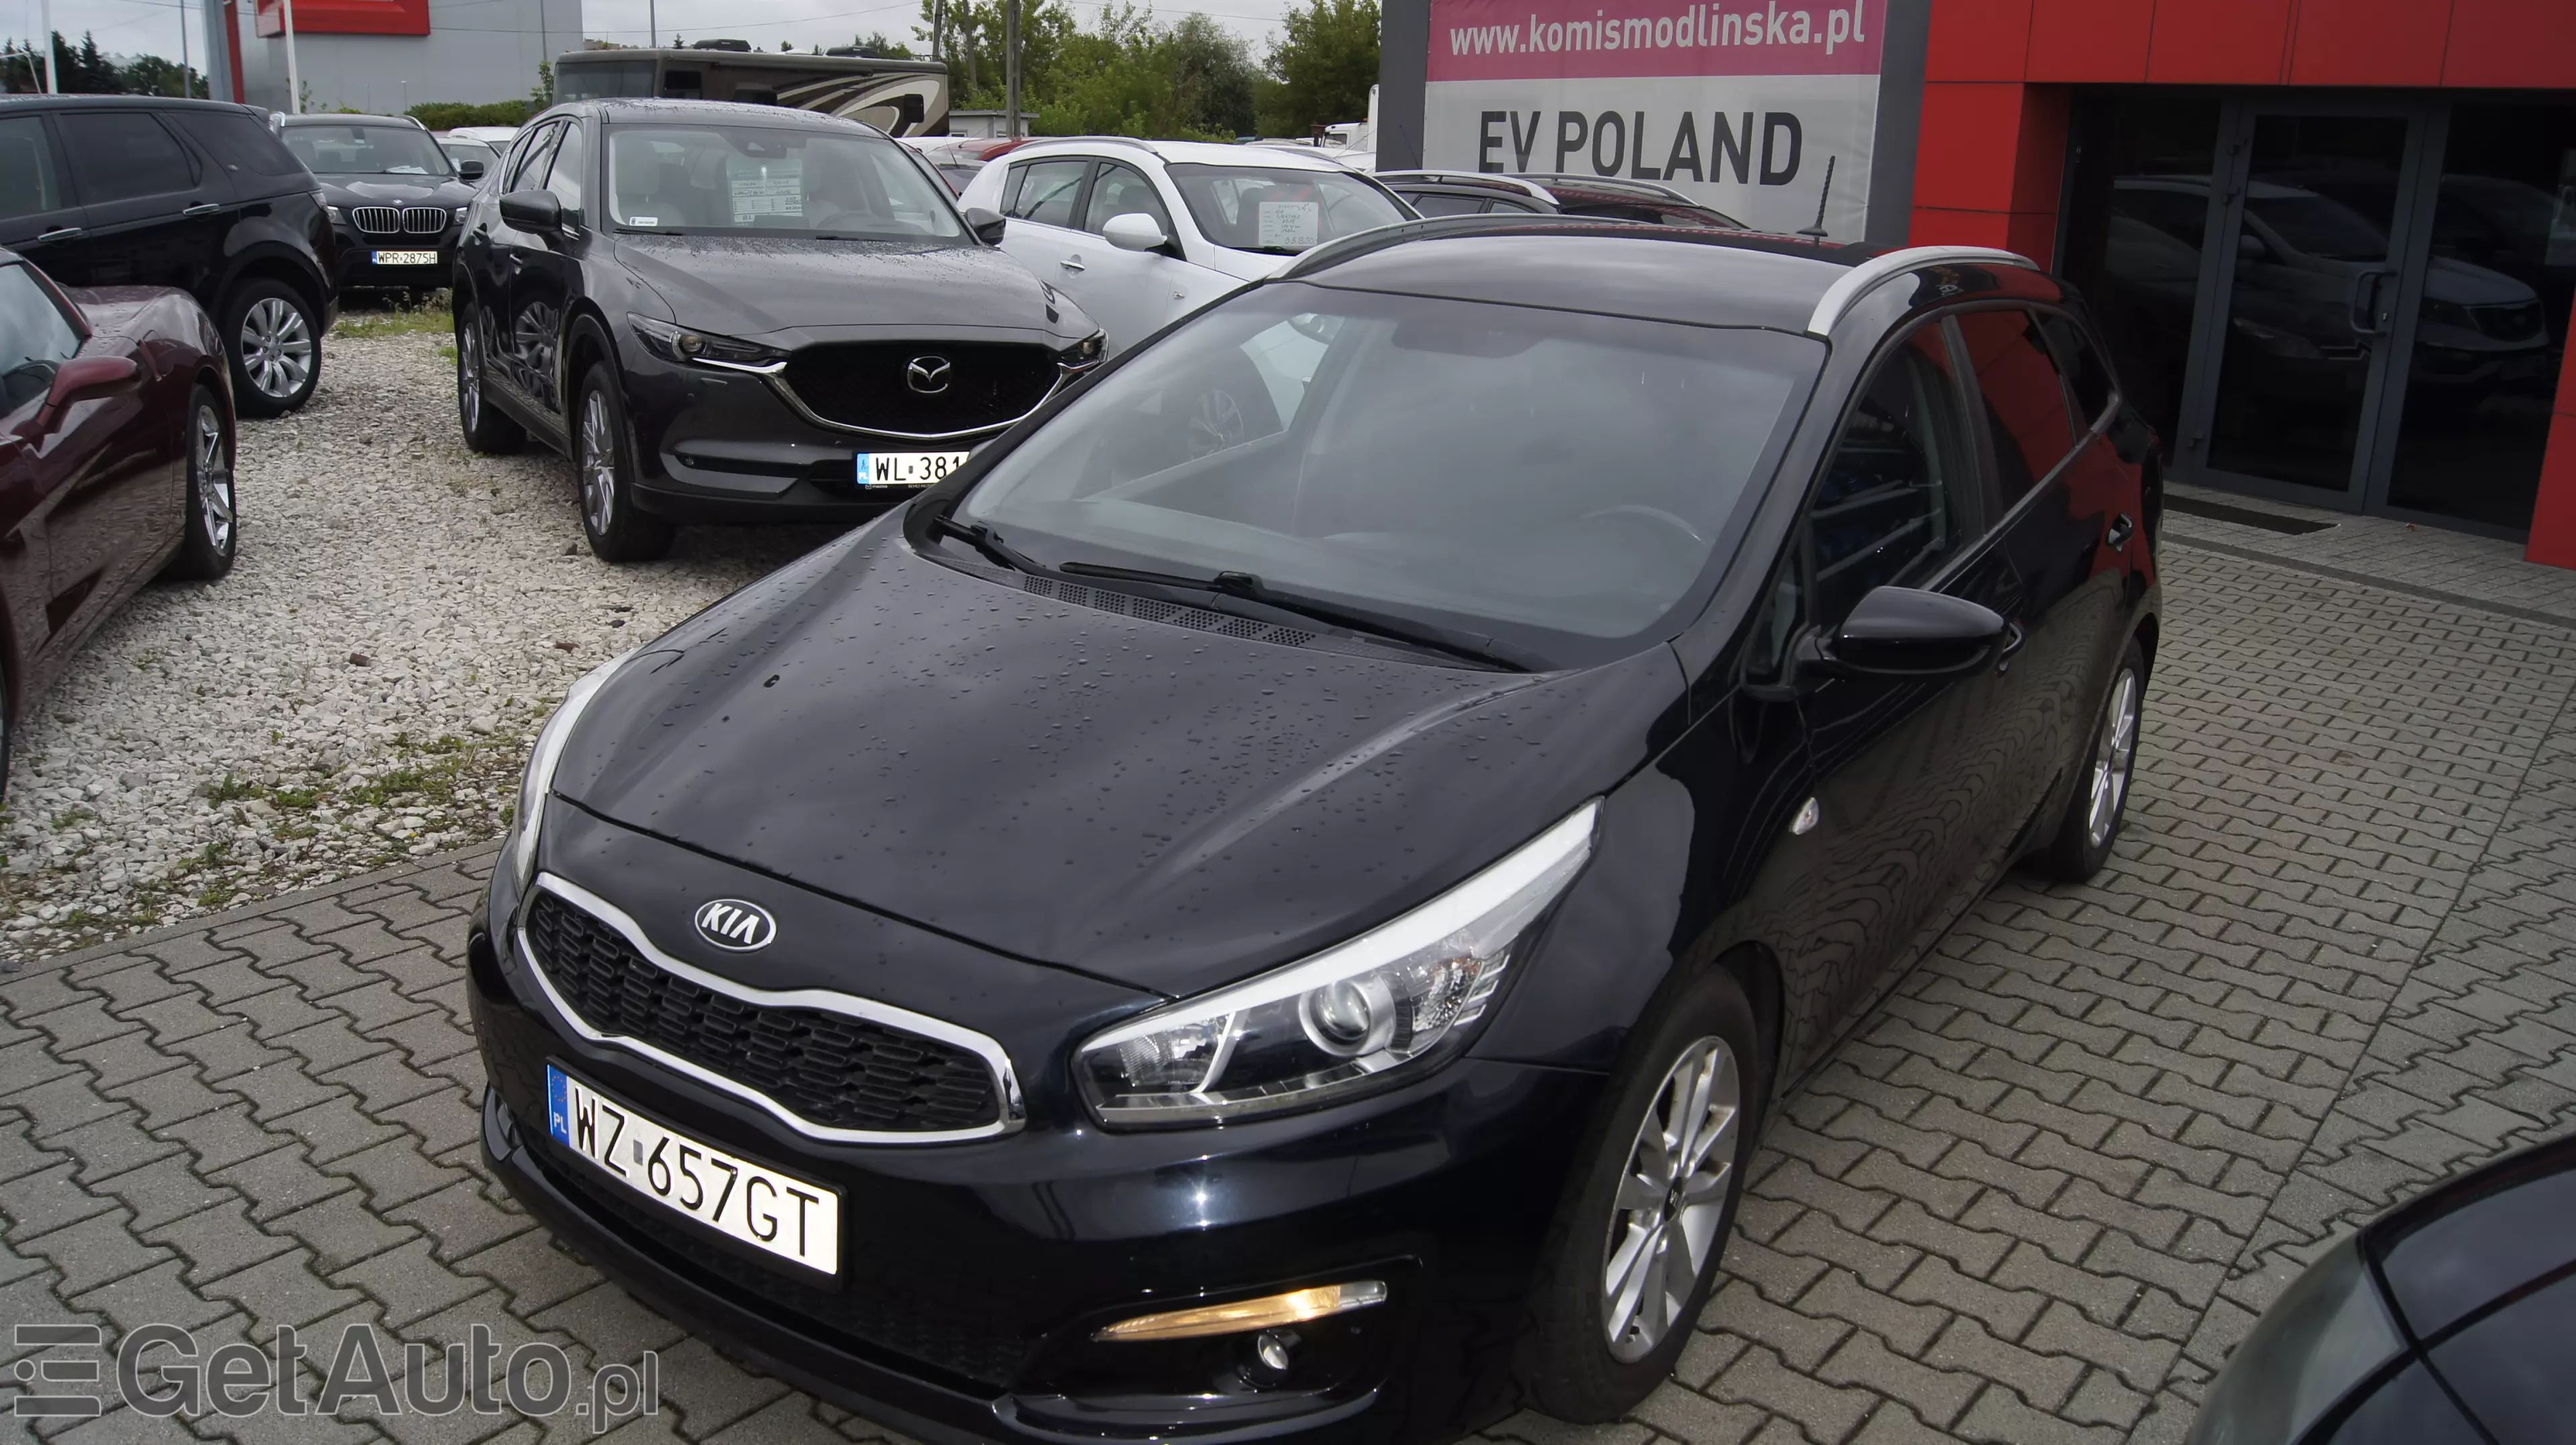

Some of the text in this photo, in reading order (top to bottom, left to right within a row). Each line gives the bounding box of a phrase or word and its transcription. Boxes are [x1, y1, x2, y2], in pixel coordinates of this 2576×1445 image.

[1450, 0, 1865, 56] www.komismodlinska.pl
[1479, 110, 1803, 186] EV POLAND
[378, 252, 436, 264] WPR 2875H
[875, 456, 960, 481] WL 381
[701, 902, 760, 945] KIA
[553, 1111, 567, 1134] PL
[574, 1085, 820, 1257] WZ 657GT
